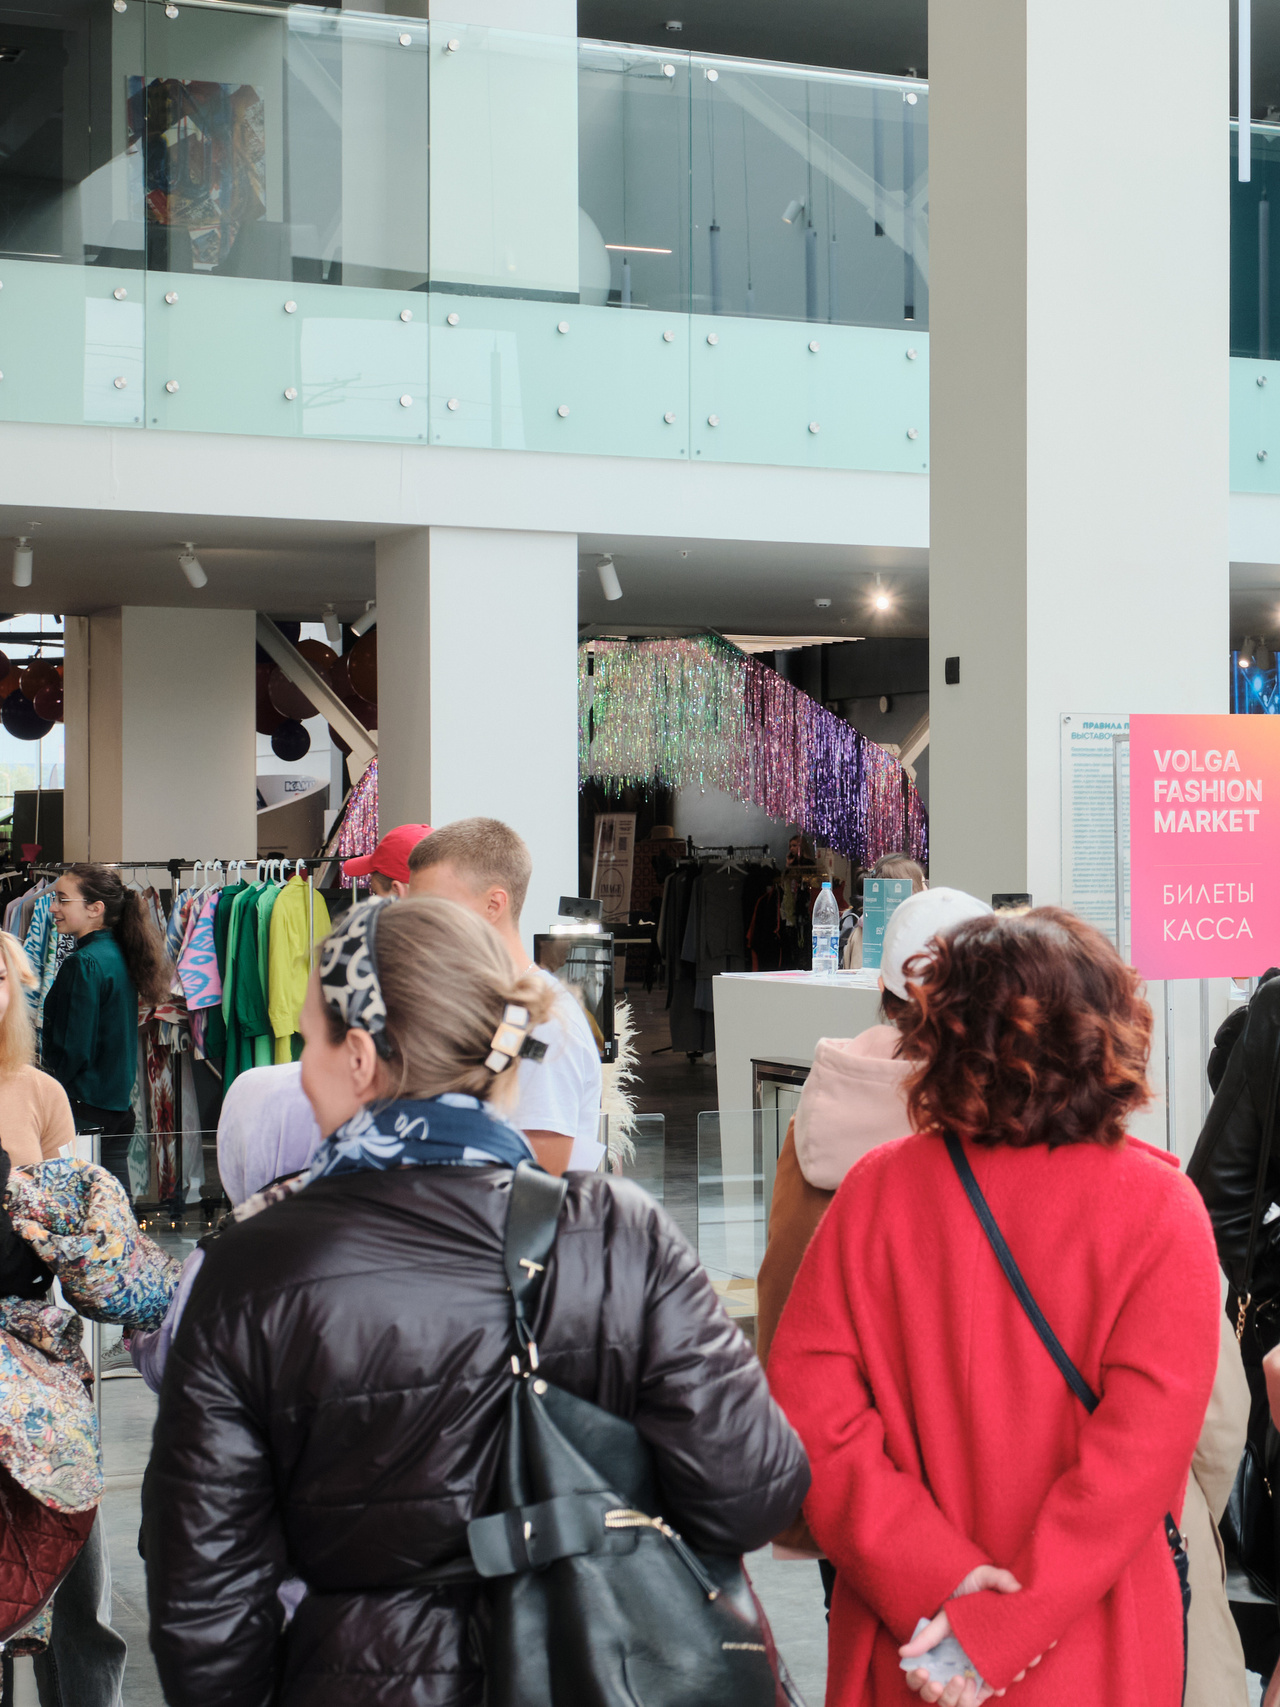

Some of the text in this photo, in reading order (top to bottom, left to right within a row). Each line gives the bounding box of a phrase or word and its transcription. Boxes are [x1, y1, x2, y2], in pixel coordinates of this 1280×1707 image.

[1082, 721, 1122, 730] ПРАВИЛА
[1153, 749, 1241, 772] VOLGA
[1154, 779, 1263, 802] FASHION
[1154, 809, 1260, 833] MARKET
[600, 883, 623, 894] IMAGE
[1163, 882, 1254, 905] БИЛЕТЫ
[1163, 917, 1253, 941] КАССА
